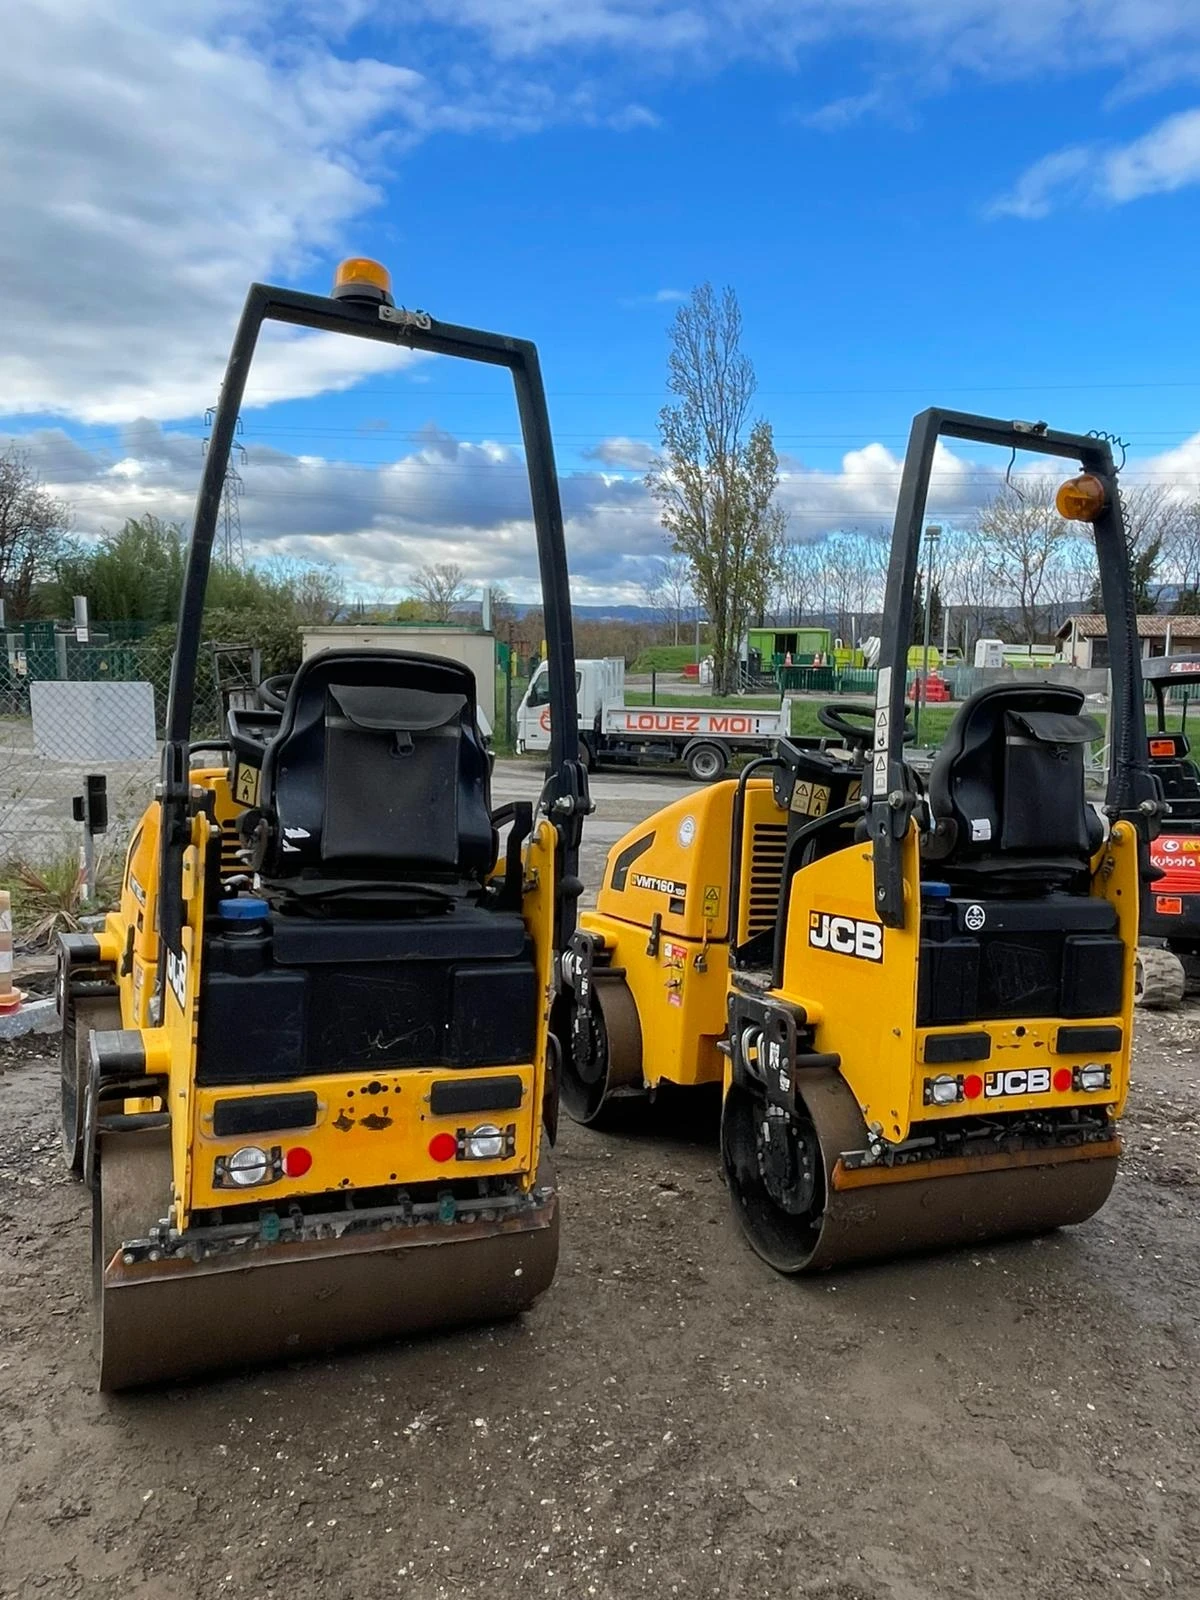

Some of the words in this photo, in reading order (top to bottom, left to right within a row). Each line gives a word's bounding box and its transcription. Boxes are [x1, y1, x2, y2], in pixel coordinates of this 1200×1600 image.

[626, 714, 700, 731] LOUEZ
[1150, 855, 1196, 867] Kubota
[809, 914, 882, 959] JCB
[985, 1068, 1050, 1096] JCB
